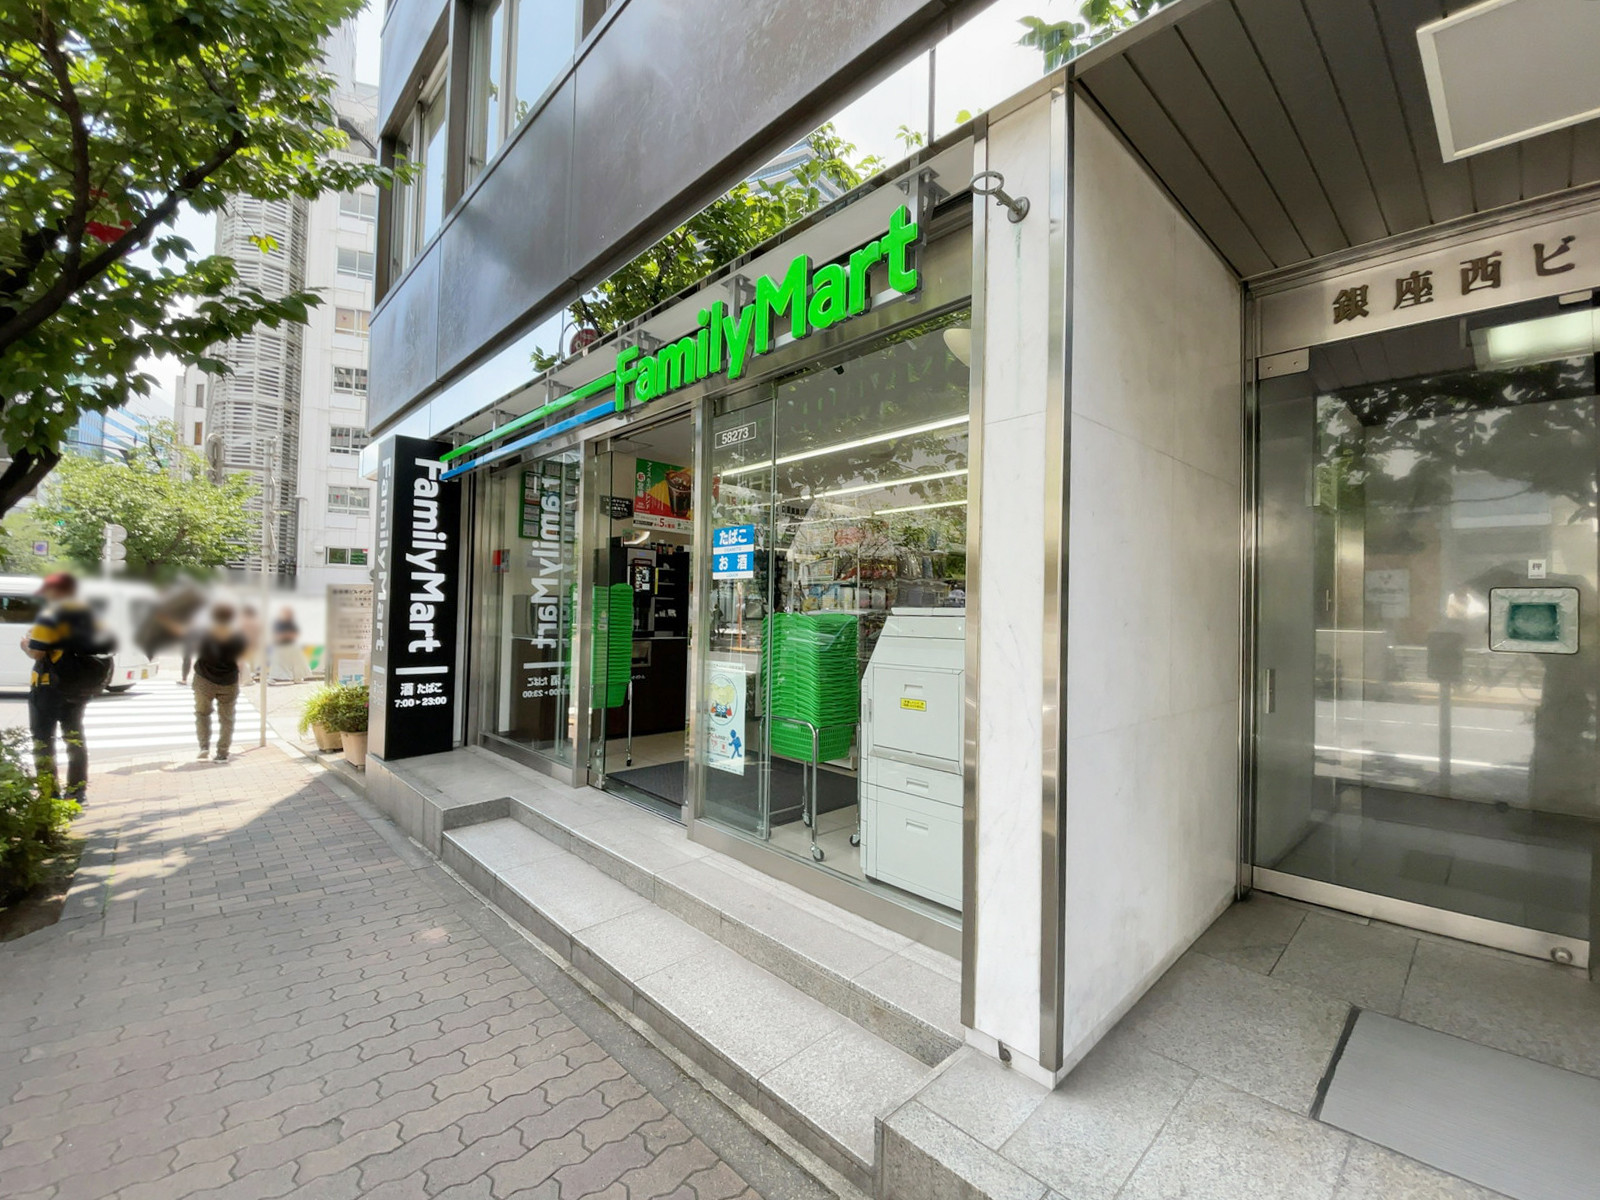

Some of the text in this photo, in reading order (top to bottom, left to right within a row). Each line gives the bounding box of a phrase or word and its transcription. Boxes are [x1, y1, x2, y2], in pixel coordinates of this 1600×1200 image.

[1333, 235, 1576, 324] 銀座西ビ
[615, 204, 918, 412] FamilyMart
[721, 427, 749, 445] 58273
[719, 529, 747, 545] たばこ
[405, 457, 449, 653] FamilyMart
[718, 554, 748, 570] お酒
[400, 682, 414, 696] 酒
[417, 682, 443, 694] たばこ
[394, 696, 447, 708] 7:00 23:00
